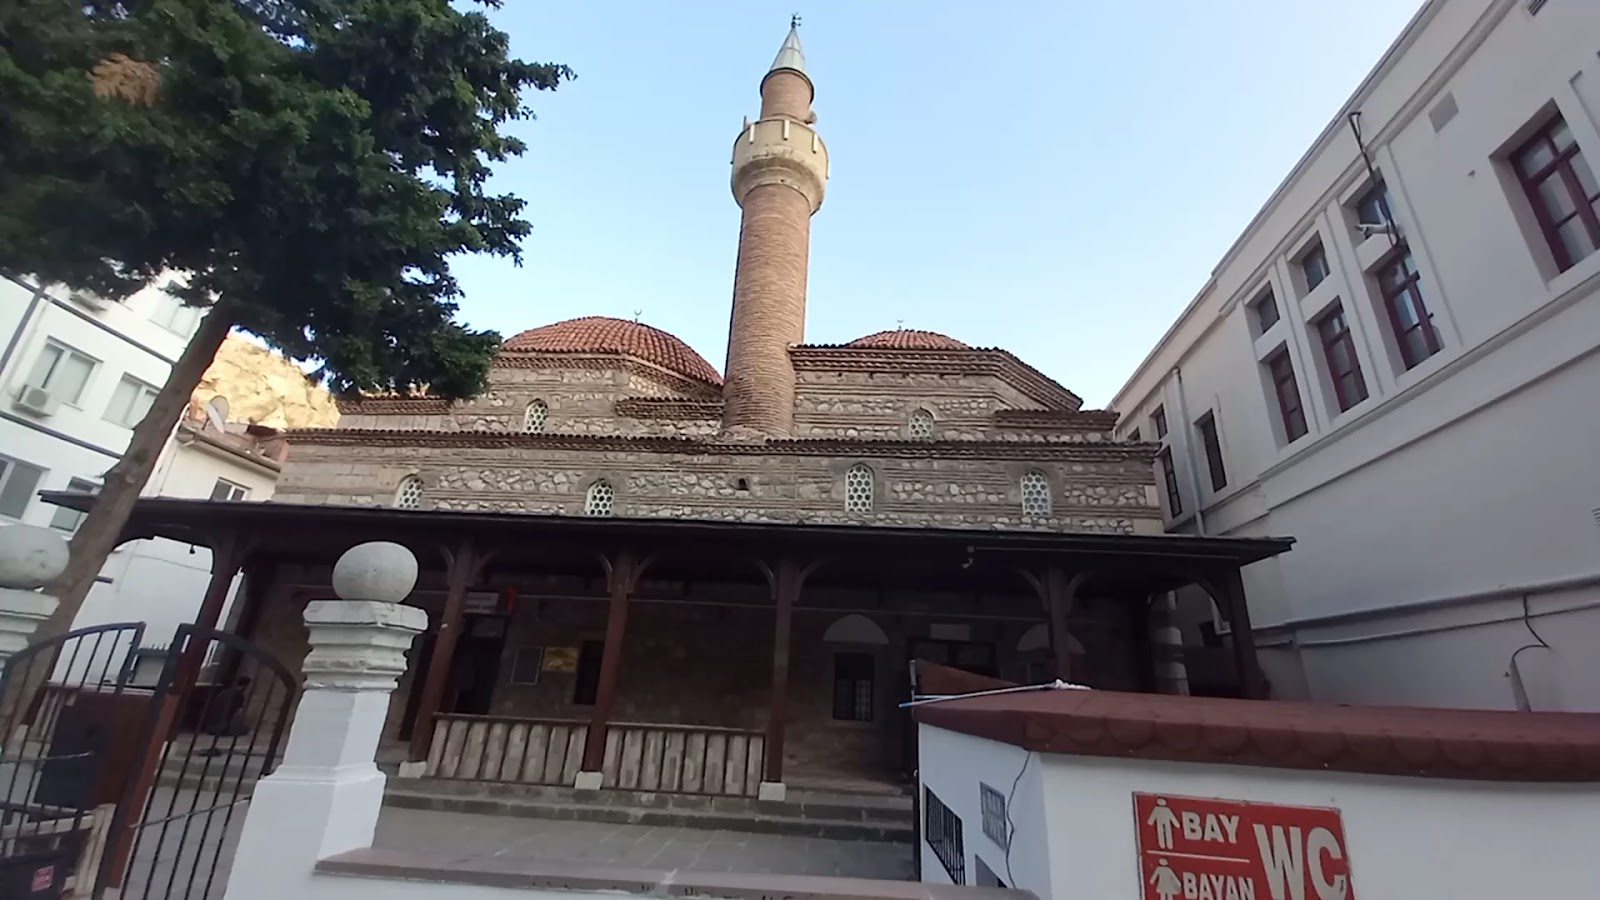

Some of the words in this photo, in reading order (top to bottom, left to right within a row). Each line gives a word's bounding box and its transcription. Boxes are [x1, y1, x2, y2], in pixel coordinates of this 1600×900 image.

[1182, 811, 1240, 844] BAY
[1253, 823, 1347, 900] WC
[1183, 872, 1255, 900] BAYAN
